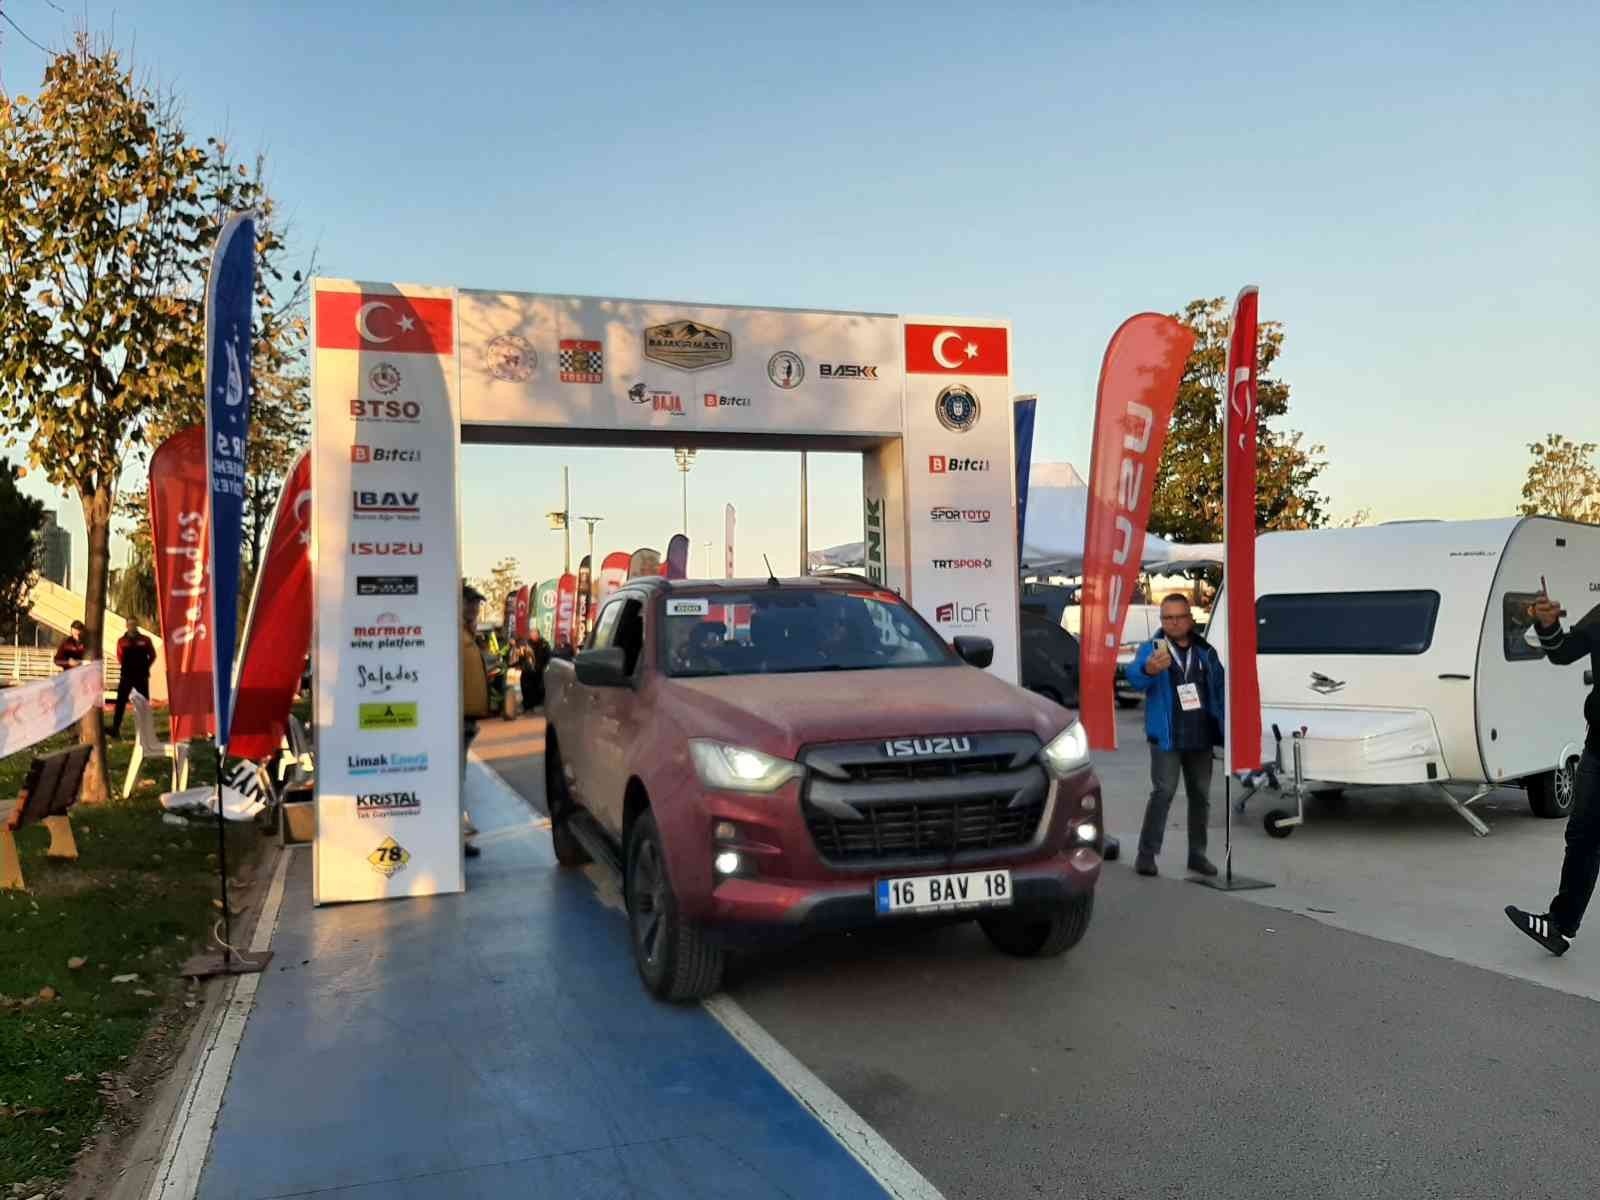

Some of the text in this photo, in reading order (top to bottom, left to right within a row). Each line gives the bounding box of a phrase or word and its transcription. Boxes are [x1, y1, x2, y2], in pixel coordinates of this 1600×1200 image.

[350, 399, 420, 418] BTSO
[360, 491, 419, 506] BAV
[351, 542, 423, 556] ISUZU
[354, 626, 423, 637] marmara
[377, 637, 426, 649] platform
[886, 736, 970, 756] ISUZU
[348, 754, 388, 768] Limak
[376, 846, 402, 862] 78
[892, 873, 1006, 905] 16 BAV 18
